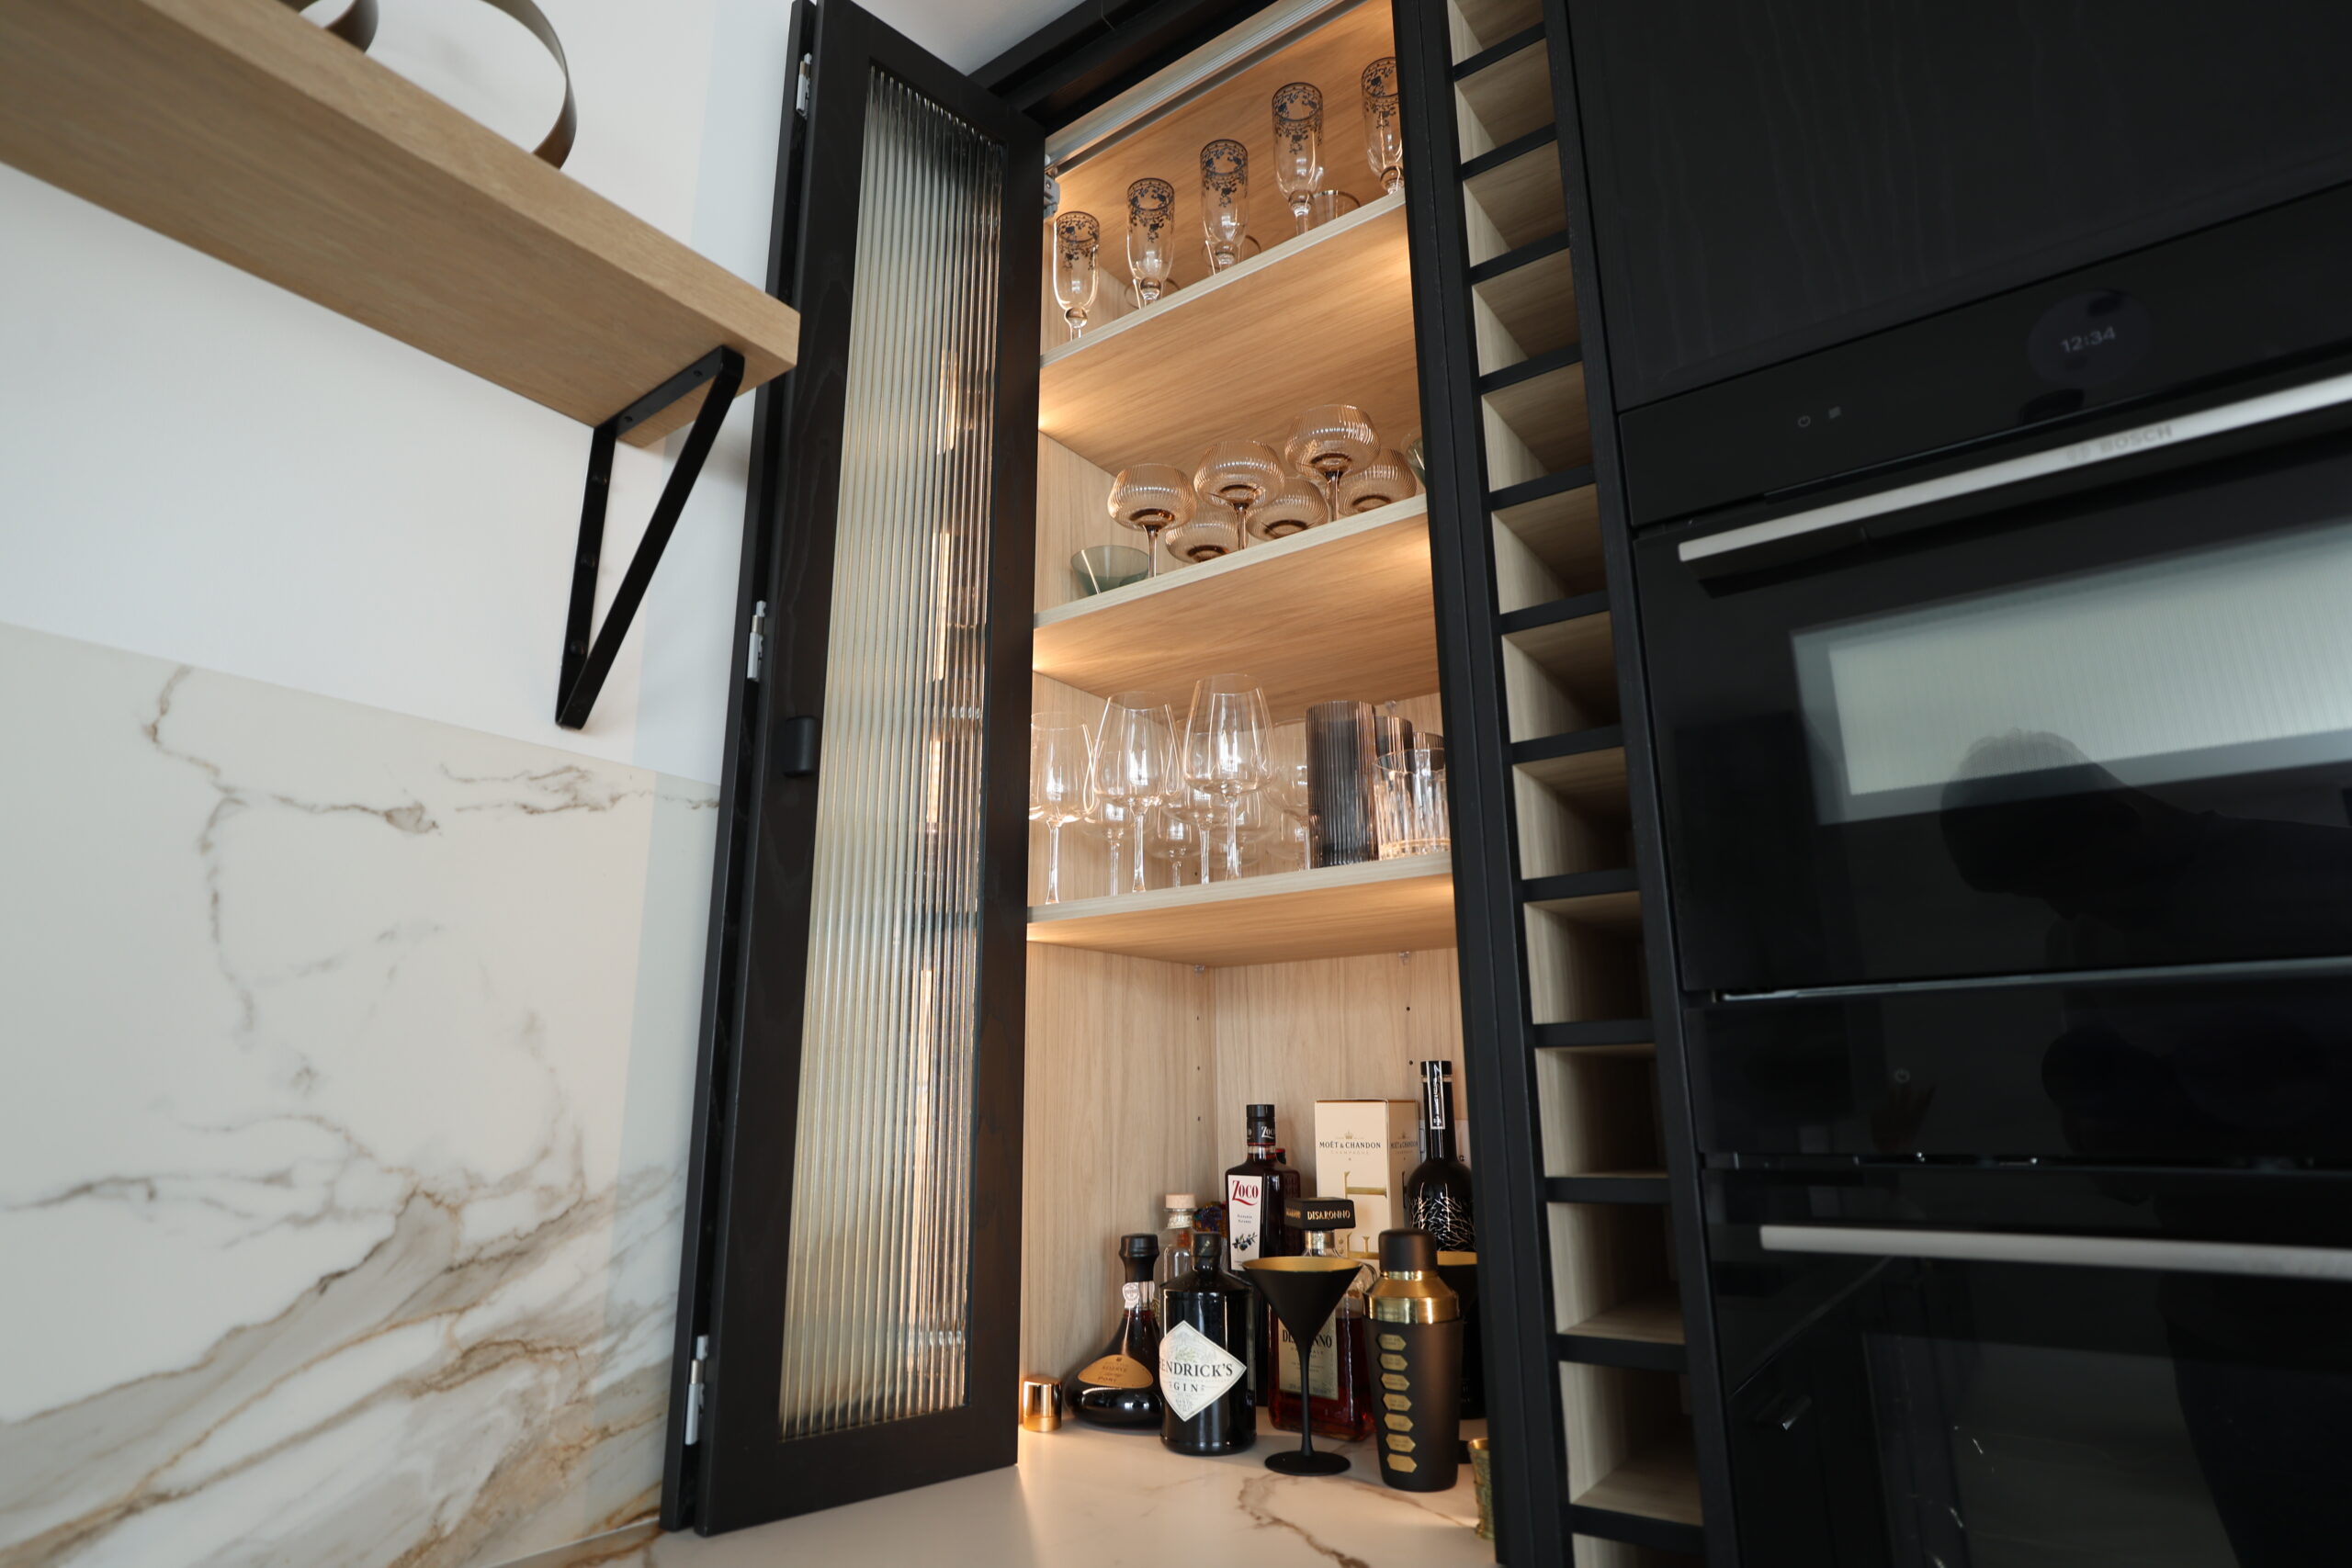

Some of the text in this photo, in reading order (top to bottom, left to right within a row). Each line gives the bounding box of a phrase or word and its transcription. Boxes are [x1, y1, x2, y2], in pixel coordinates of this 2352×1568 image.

[2061, 326, 2116, 353] 12:34
[2100, 424, 2172, 453] BOSCH
[1307, 1210, 1351, 1220] DISARONNO
[1160, 1359, 1233, 1377] ENDRICK'S
[1173, 1382, 1198, 1393] GIN
